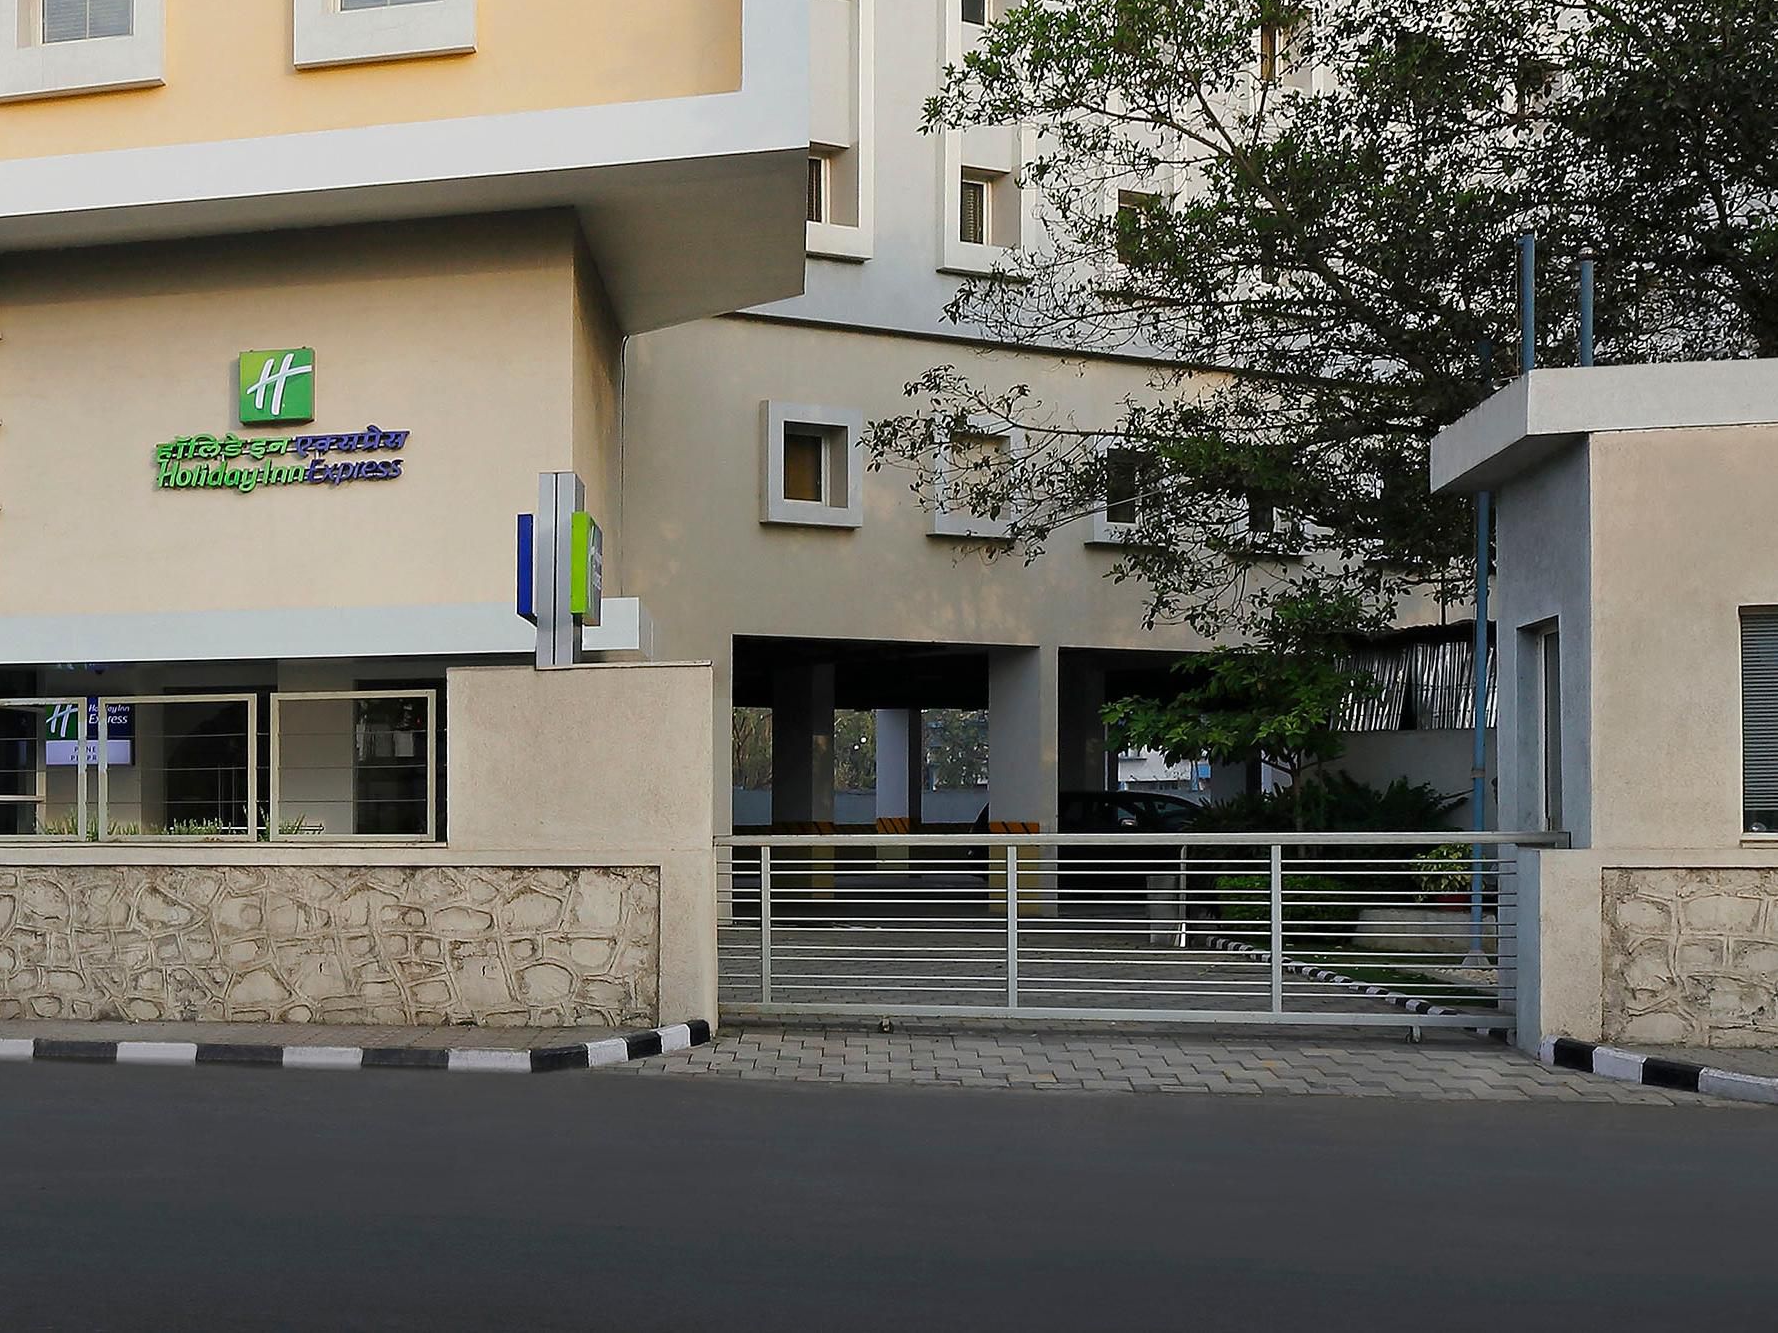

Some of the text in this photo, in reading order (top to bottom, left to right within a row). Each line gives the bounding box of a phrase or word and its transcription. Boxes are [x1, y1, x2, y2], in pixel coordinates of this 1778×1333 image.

[156, 424, 410, 464] हॉलिडे इन एक्सप्रेस
[157, 458, 404, 493] Holiday Inn Express
[88, 713, 128, 724] Exress
[74, 745, 96, 753] PNE
